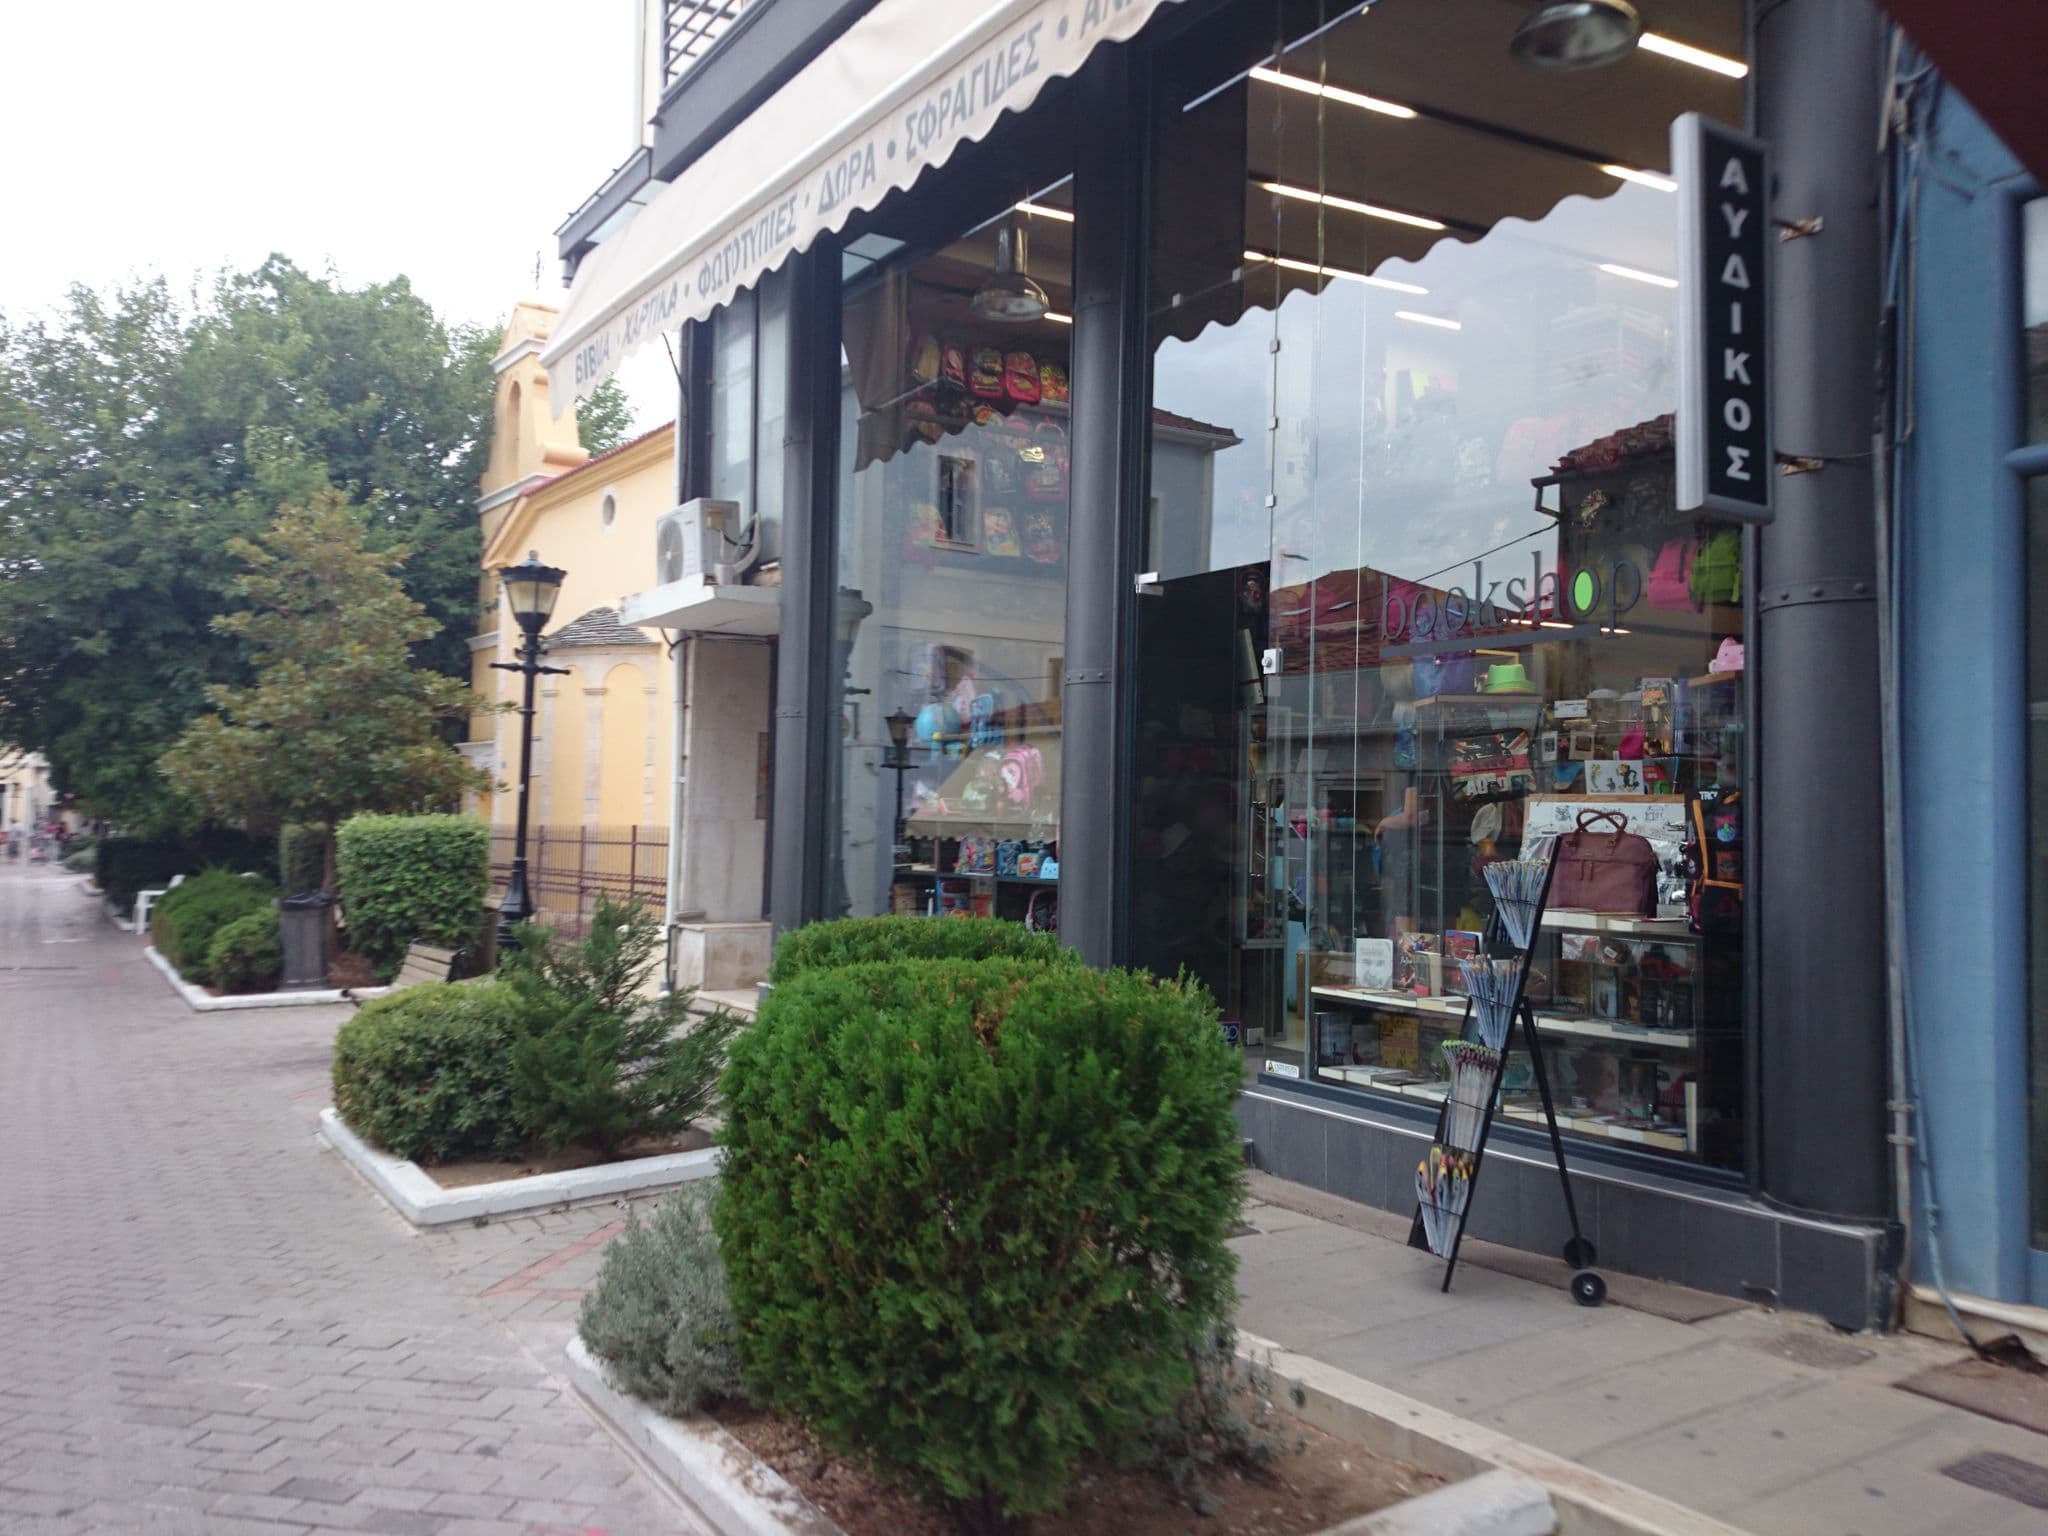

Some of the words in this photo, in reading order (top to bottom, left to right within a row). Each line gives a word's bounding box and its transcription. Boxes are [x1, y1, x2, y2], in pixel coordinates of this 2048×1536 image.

[697, 191, 798, 299] ΦΩΤΟΤΥΠΙΕΣ
[817, 140, 877, 216] ΔΩΡΑ
[903, 20, 1043, 163] ΣΦΡΑΓΙΔΕΣ
[1719, 156, 1752, 481] ΑΥΔΙΚΟΣ
[1381, 549, 1642, 641] bookshop
